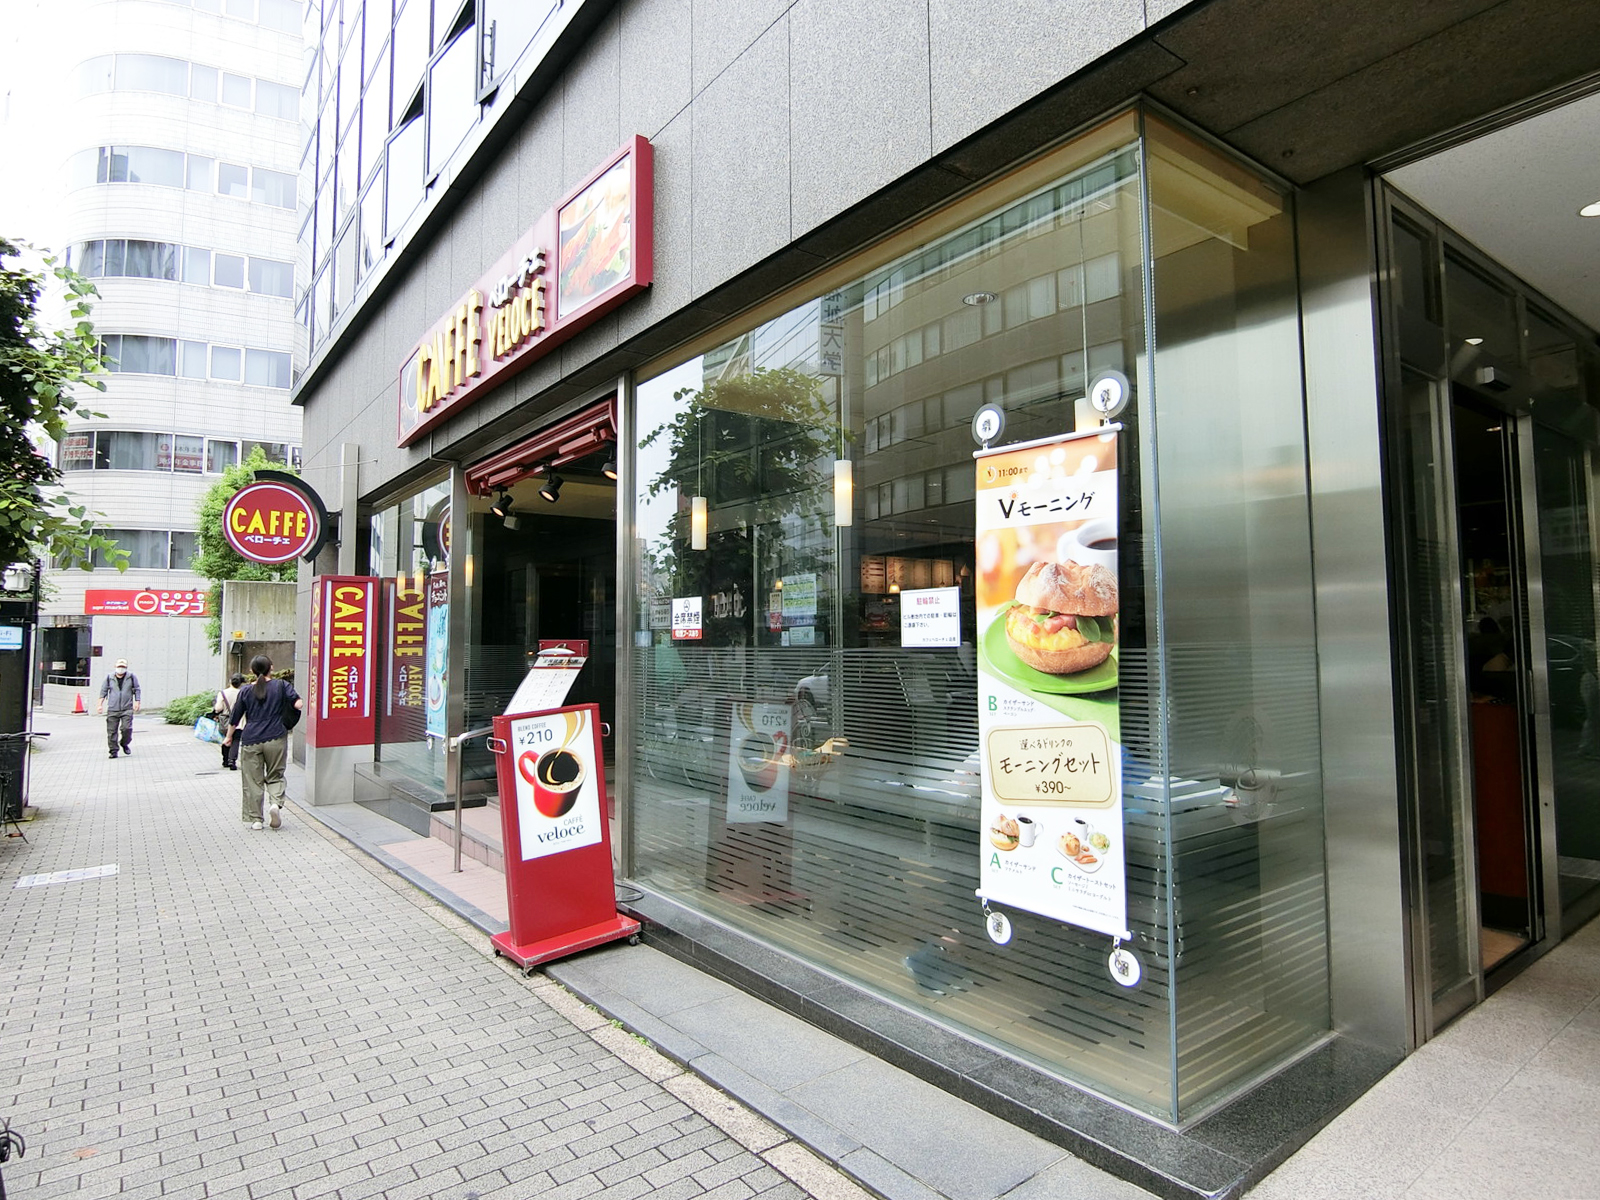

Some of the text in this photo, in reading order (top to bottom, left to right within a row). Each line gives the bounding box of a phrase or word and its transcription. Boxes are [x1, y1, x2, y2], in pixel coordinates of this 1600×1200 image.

[487, 247, 546, 309] ベローチェ
[486, 277, 546, 362] VELOCE
[232, 507, 307, 537] CAFFÈ
[244, 535, 291, 545] ベローチェ
[160, 599, 206, 615] ピアゴ
[674, 611, 700, 625] 全席禁煙
[332, 587, 365, 709] CAFFÈ VELOCE
[349, 666, 358, 708] ベローチェ
[988, 695, 998, 711] B
[519, 729, 553, 745] ¥210
[1018, 738, 1073, 750] 選べるドリンクの
[1000, 752, 1100, 775] モーニングセット
[537, 823, 586, 843] veloce
[989, 852, 1001, 869] A
[1051, 867, 1063, 885] C
